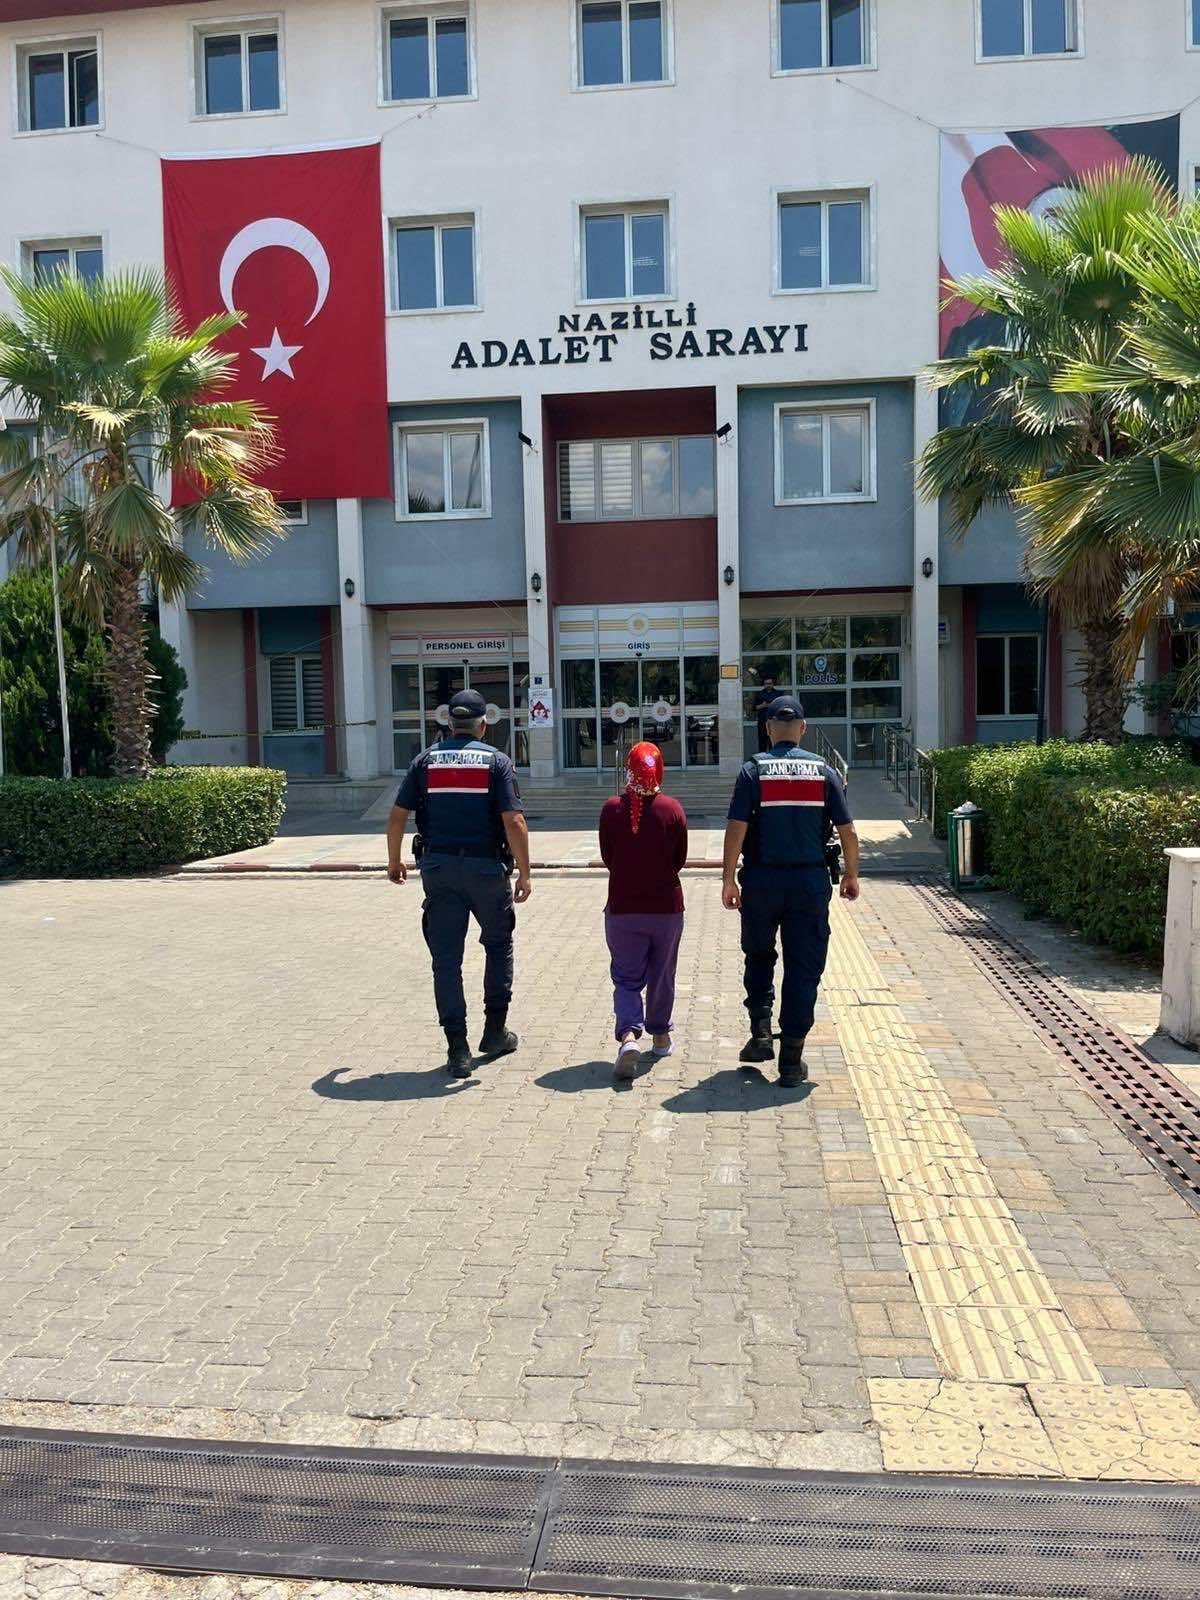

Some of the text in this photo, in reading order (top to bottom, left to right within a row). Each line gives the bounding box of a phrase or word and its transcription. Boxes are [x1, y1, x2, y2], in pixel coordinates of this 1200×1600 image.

[558, 302, 697, 333] NAZİLLİ
[451, 324, 809, 369] ADALET SARAYI
[426, 642, 474, 650] PERSONEL
[766, 762, 820, 775] JANDARMA
